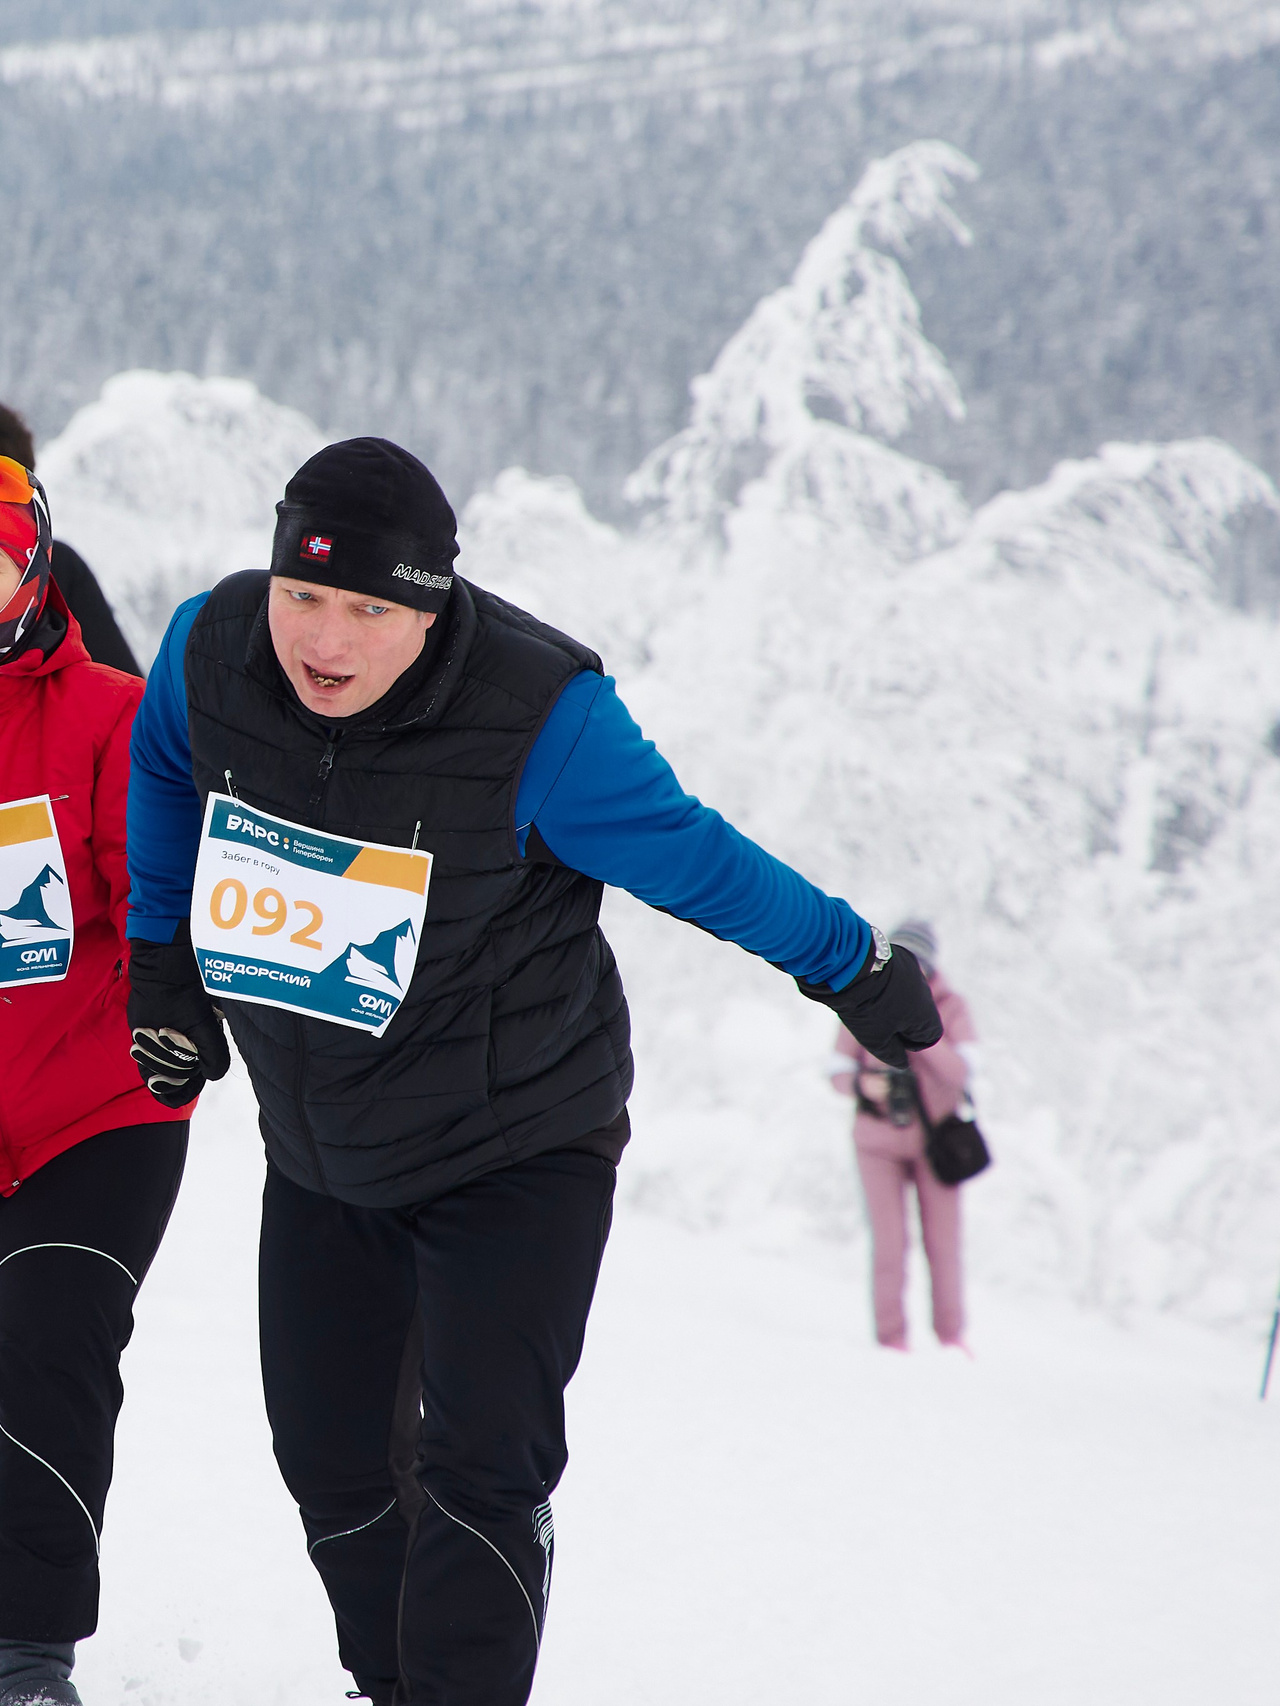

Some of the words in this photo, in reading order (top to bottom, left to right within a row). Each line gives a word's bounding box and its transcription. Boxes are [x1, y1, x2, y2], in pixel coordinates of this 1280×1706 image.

[292, 847, 334, 863] Гипербореи
[293, 840, 325, 854] Вершина
[221, 850, 251, 863] Забег
[261, 862, 280, 876] гору
[210, 878, 324, 951] 092
[205, 958, 312, 989] КОВДОРСКИЙ
[205, 969, 232, 983] ГОК
